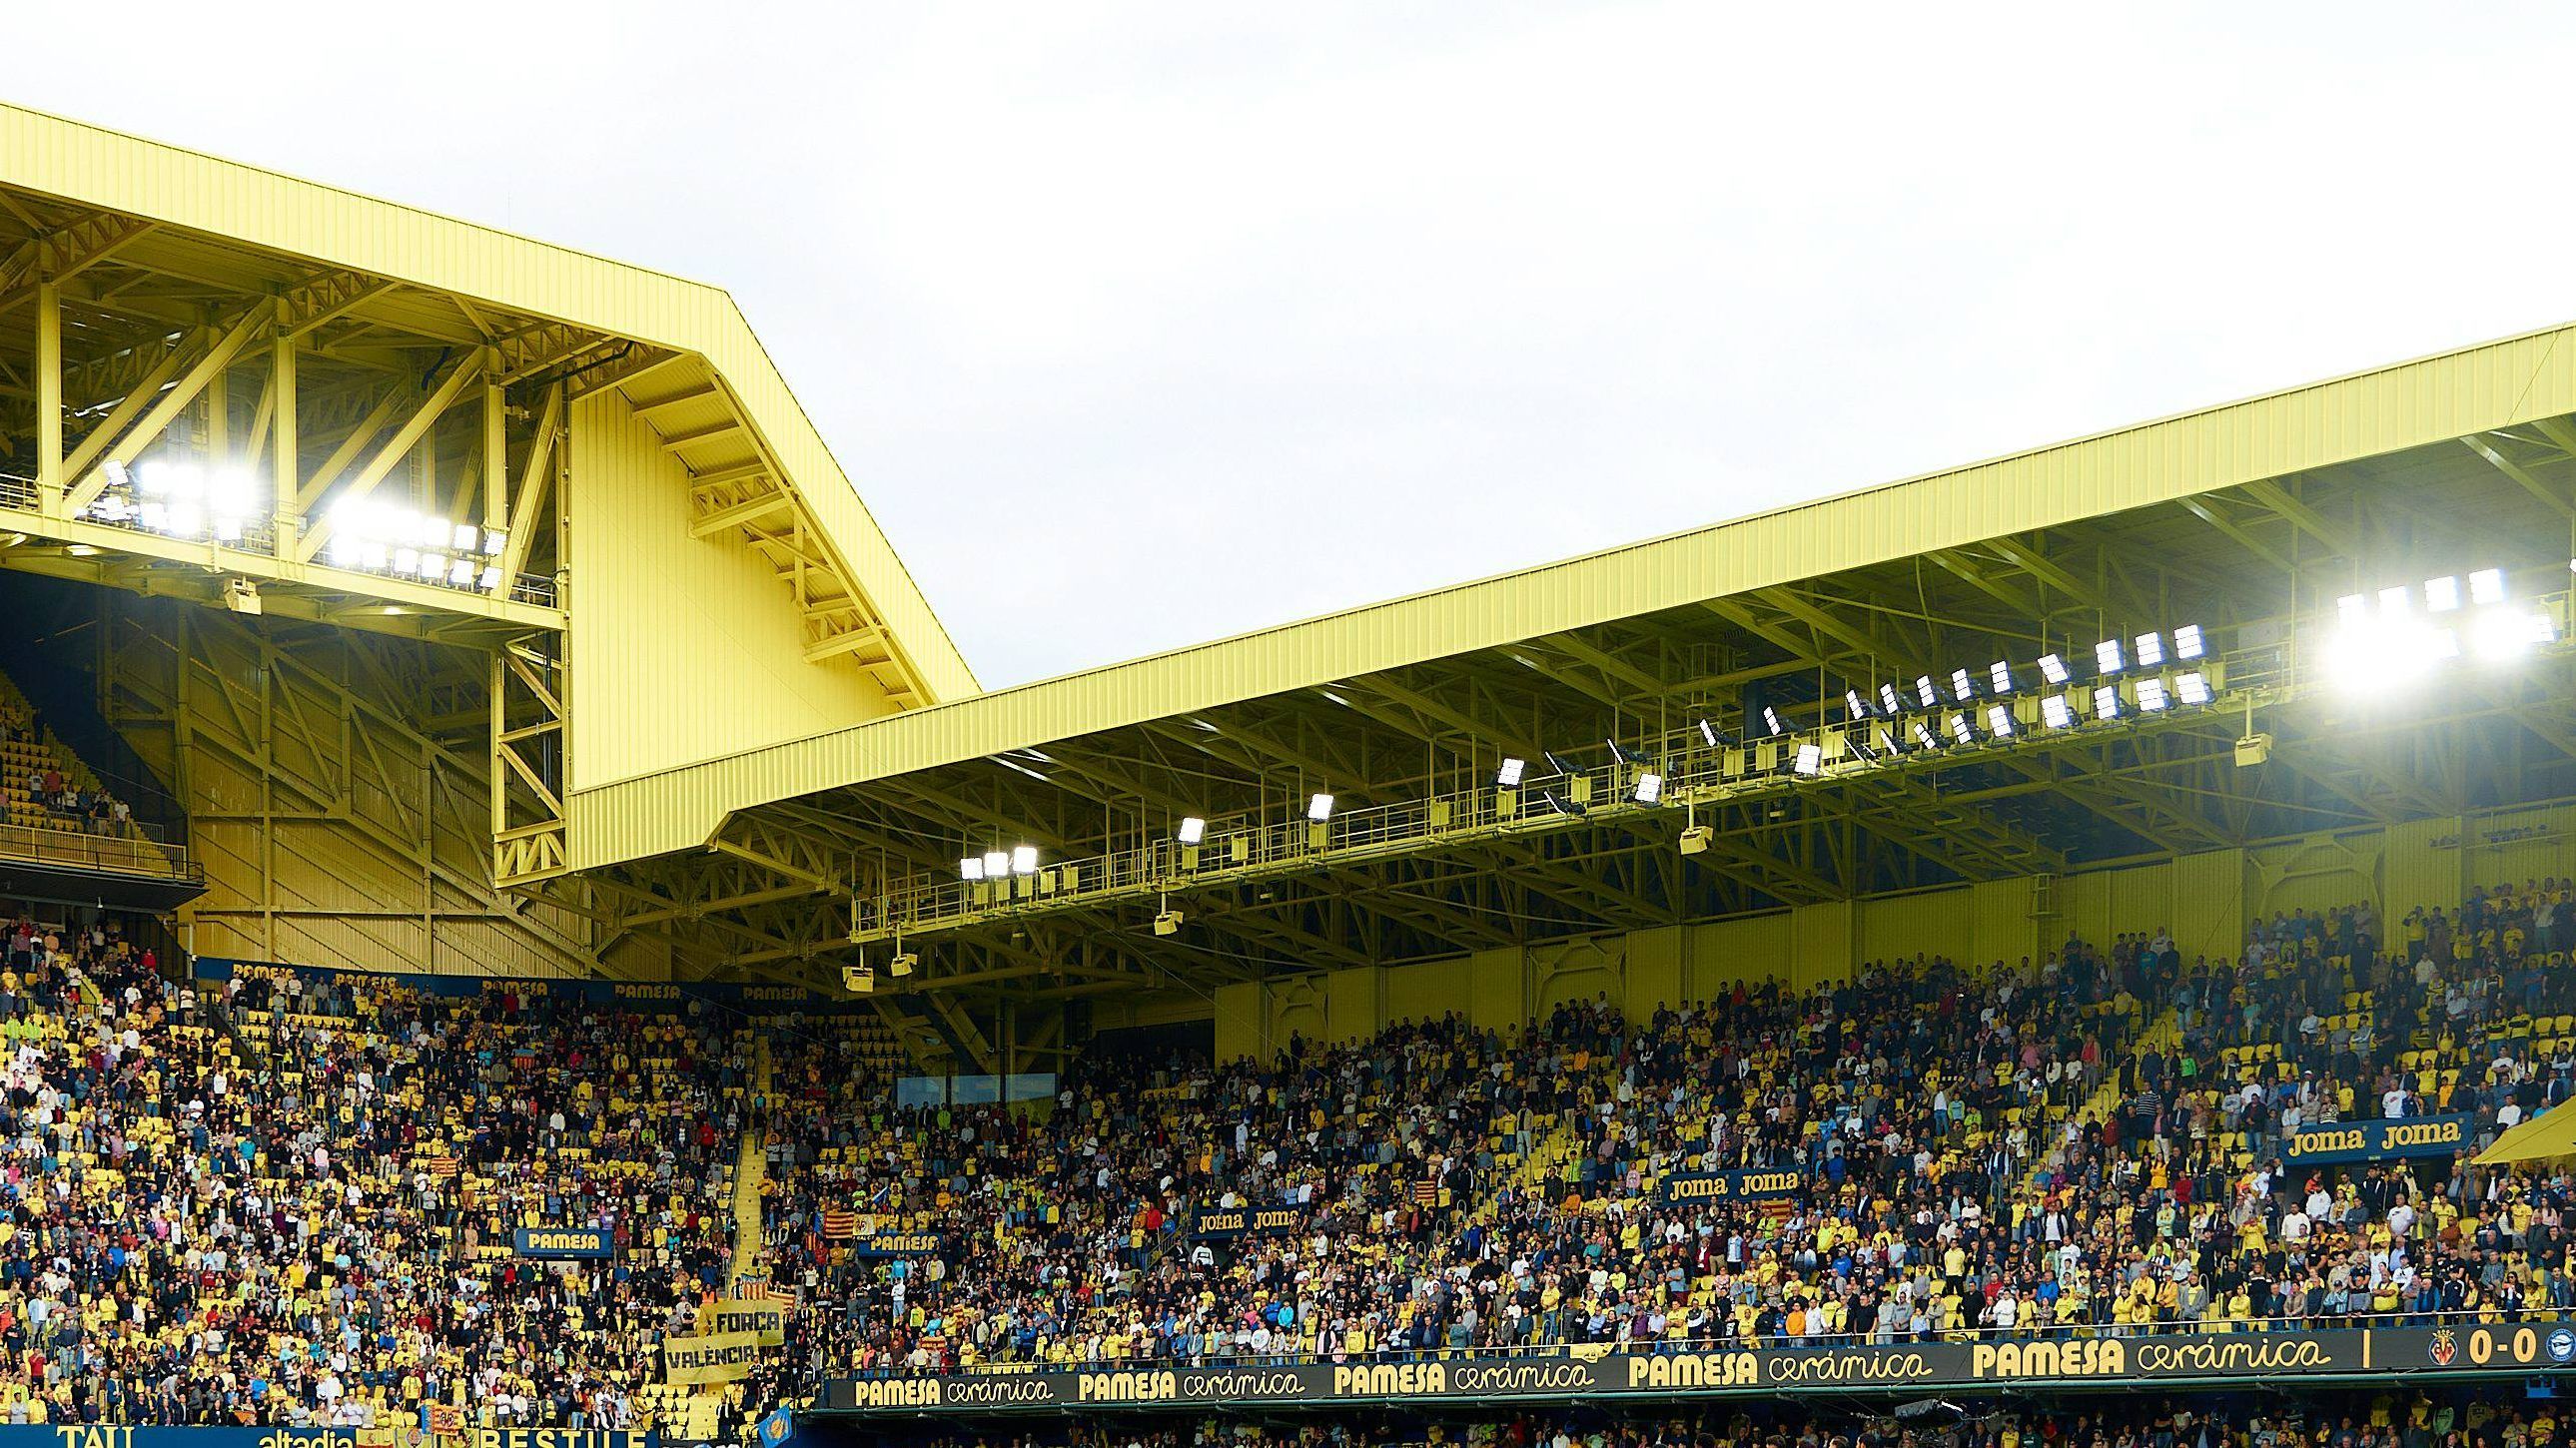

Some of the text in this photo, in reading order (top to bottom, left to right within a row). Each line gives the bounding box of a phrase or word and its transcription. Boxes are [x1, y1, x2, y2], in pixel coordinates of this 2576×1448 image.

[614, 985, 681, 999] PAMESA
[743, 987, 808, 1001] PAMESA
[528, 1233, 600, 1249] PAMESA
[716, 1311, 779, 1337] FORÇA
[667, 1345, 755, 1369] VALÈNCIA
[855, 1327, 2537, 1406] PAMESA cerámica PAMESA cerámica PAMESA cerámica PAMESA cerámica PAMESA cerámica 0-0
